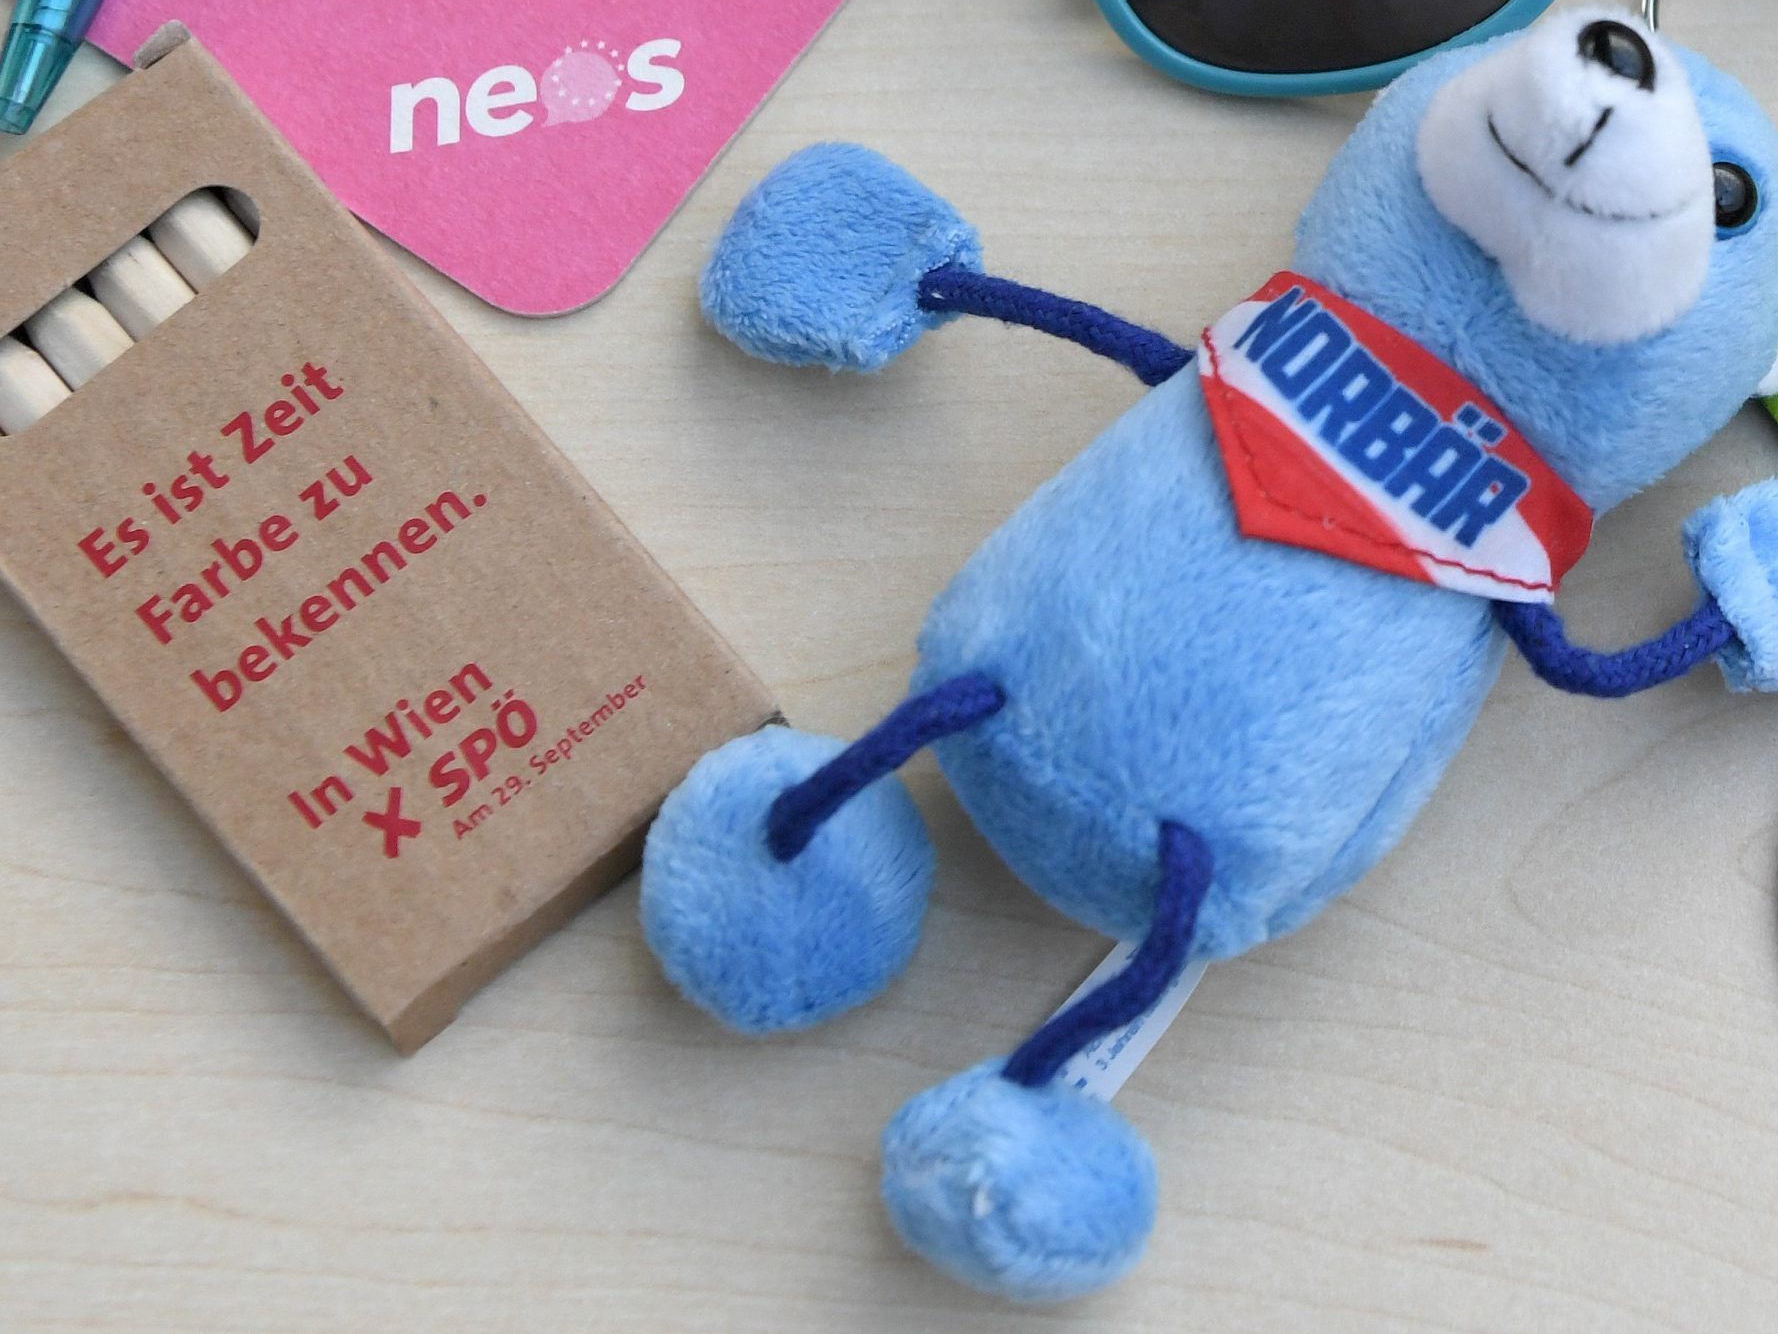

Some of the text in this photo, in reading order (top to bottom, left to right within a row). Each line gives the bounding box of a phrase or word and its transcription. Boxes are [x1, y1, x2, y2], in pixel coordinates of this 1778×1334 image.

[77, 360, 344, 580] Es ist Zeit
[1232, 285, 1531, 549] NORBÄR
[135, 453, 374, 646] Farbe zu
[188, 489, 488, 714] bekennen.
[287, 660, 494, 830] In Wien
[362, 688, 539, 860] X SPÖ
[452, 673, 648, 840] Am 29. September
